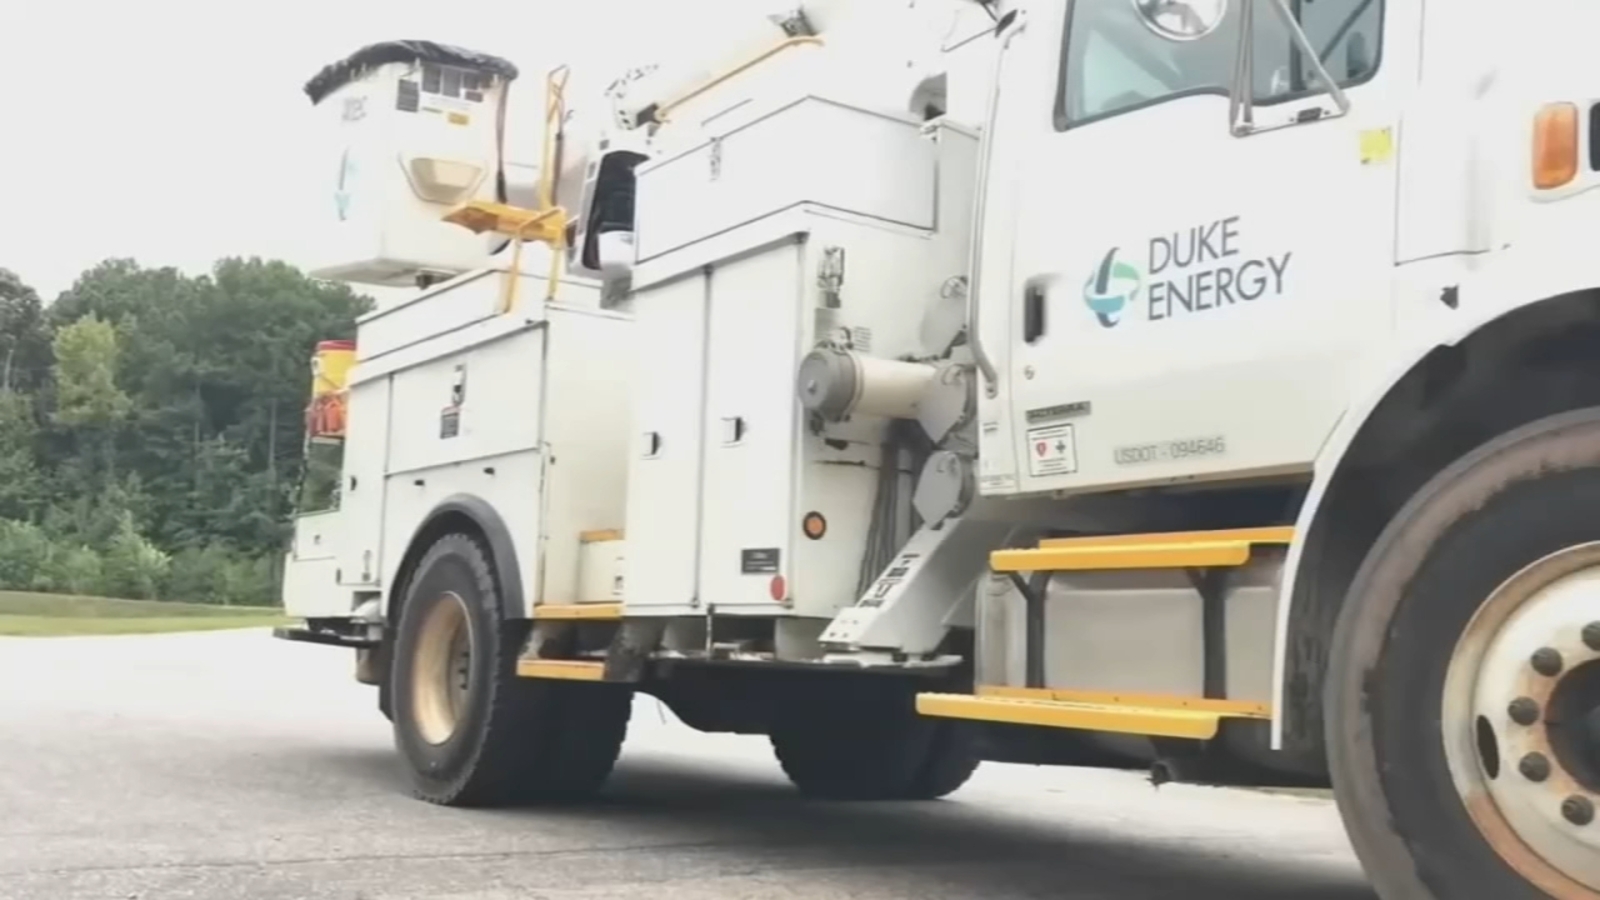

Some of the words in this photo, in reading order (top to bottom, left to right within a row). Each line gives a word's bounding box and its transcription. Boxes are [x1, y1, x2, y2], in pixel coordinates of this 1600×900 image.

[1149, 215, 1240, 275] DUKE
[1148, 251, 1292, 321] ENERGY
[1113, 444, 1158, 465] USDOT
